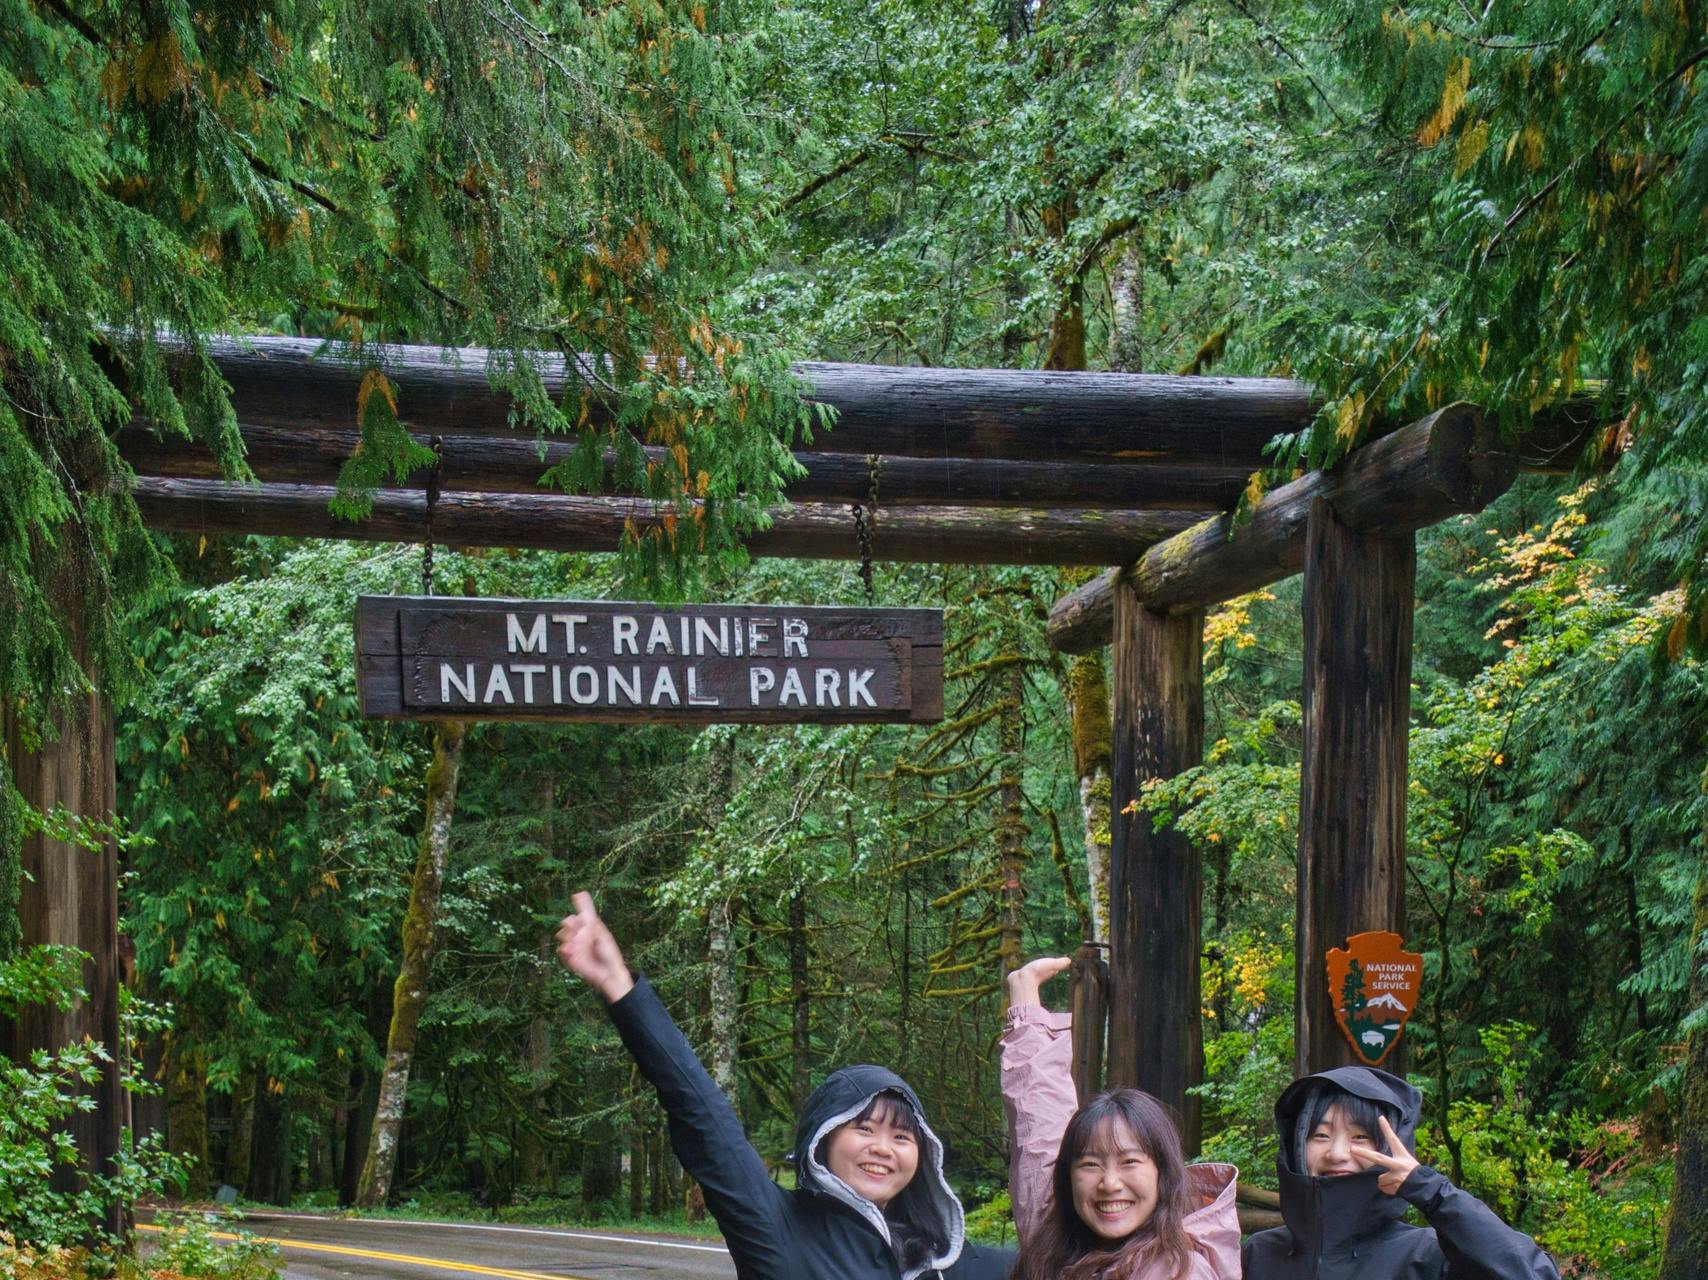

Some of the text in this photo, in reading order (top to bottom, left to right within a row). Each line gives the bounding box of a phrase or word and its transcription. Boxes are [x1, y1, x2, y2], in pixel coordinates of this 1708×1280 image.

[506, 613, 810, 659] MT. RAINIER
[439, 662, 879, 708] NATIONAL PARK
[1366, 963, 1416, 972] NATIONAL
[1378, 973, 1405, 981] PARK
[1371, 981, 1411, 990] SERVICE
